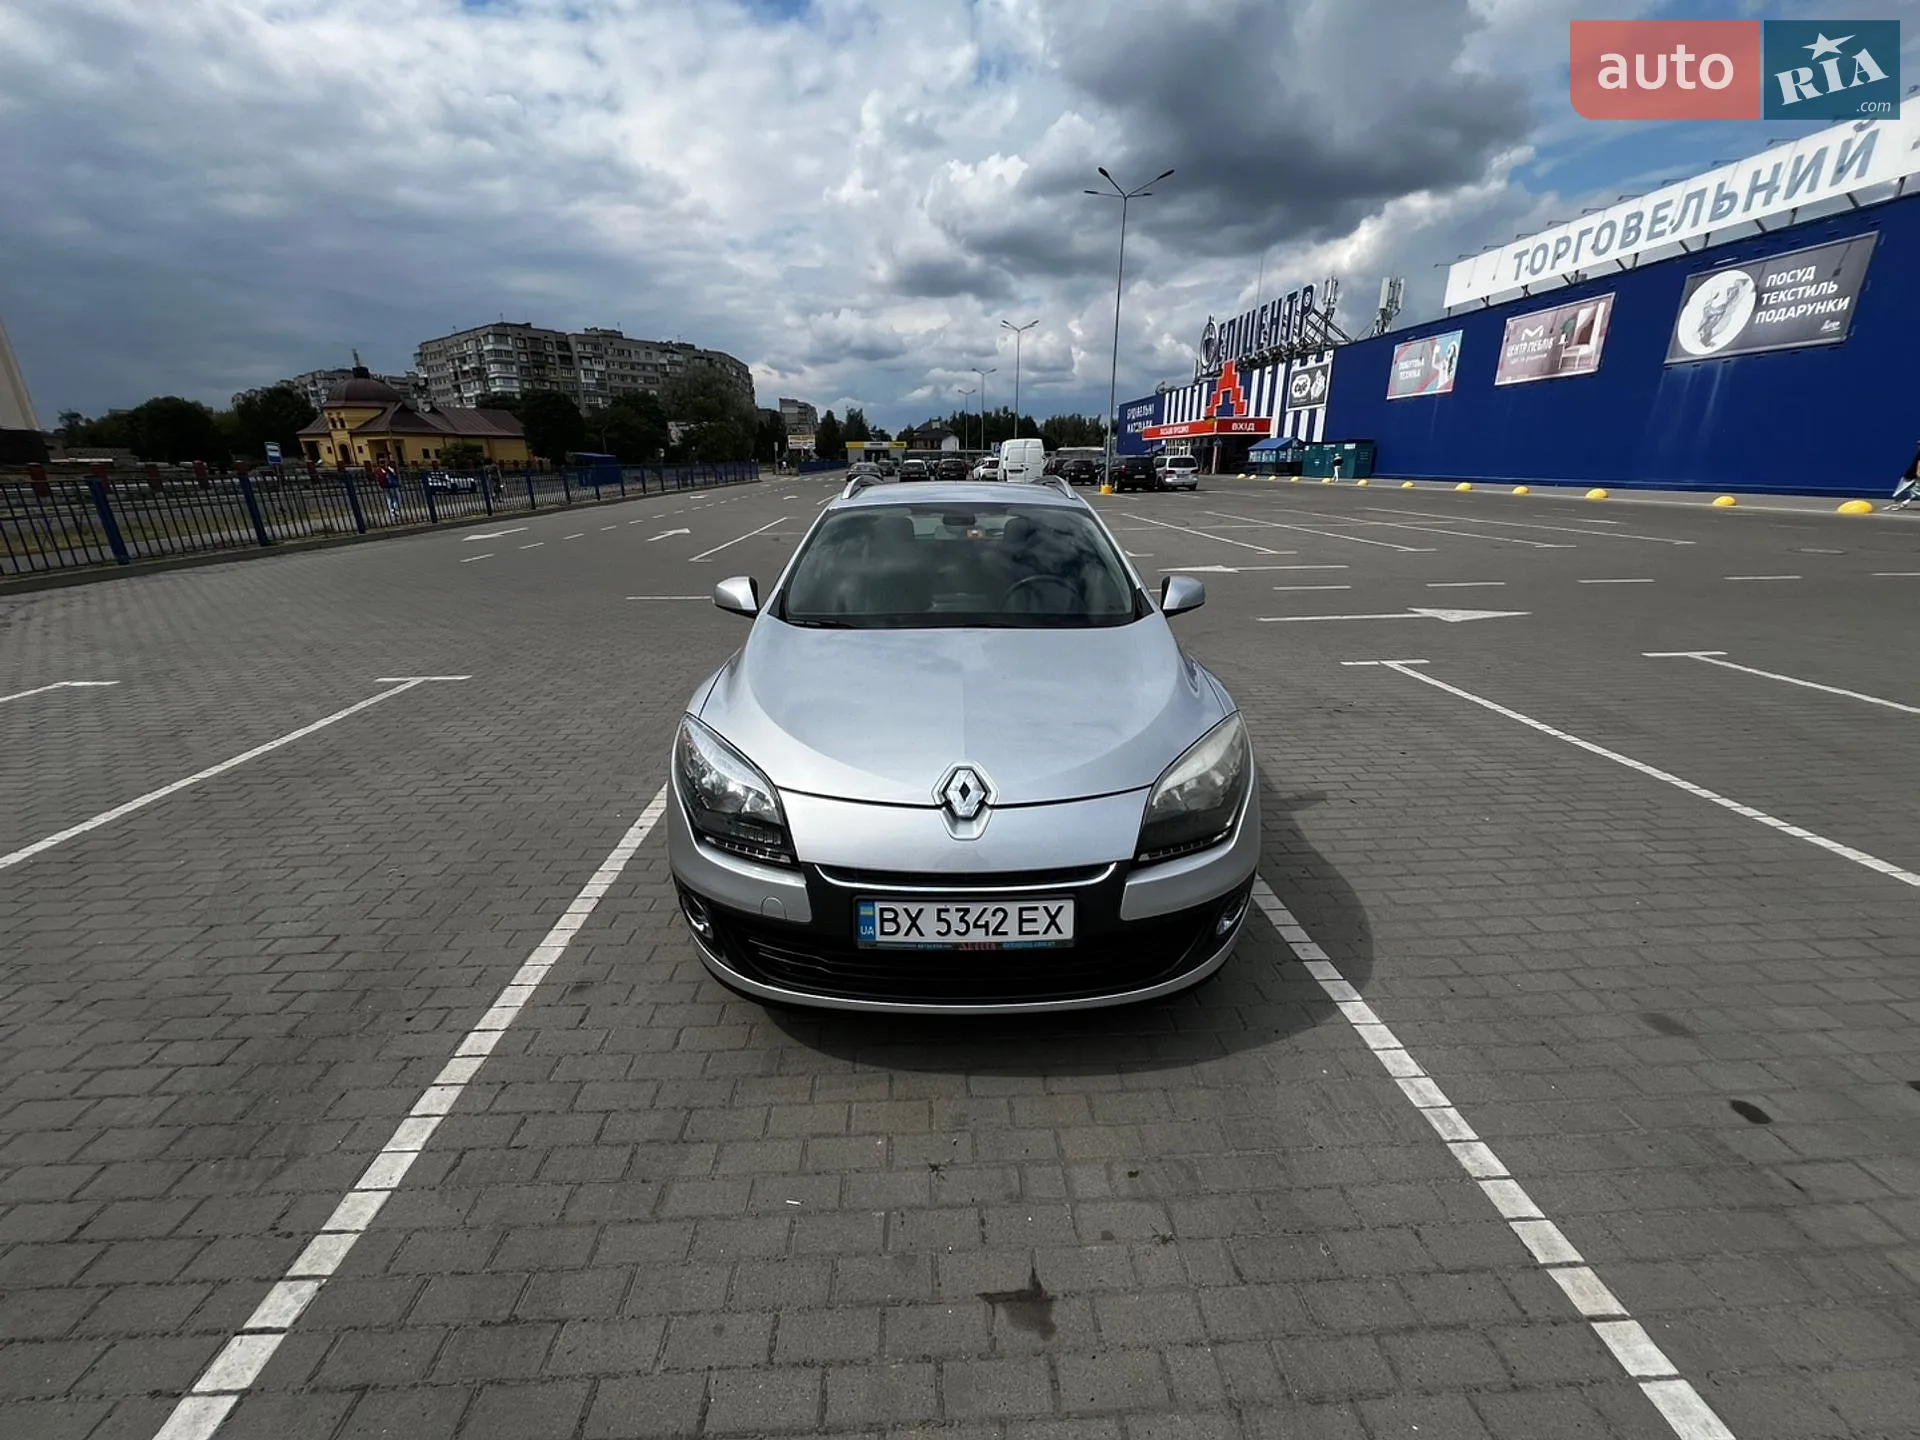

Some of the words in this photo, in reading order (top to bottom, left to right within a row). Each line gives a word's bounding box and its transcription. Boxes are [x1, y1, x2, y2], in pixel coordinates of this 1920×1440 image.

[1512, 119, 1880, 281] ТОРГОВЕЛЬНИЙ
[1765, 265, 1817, 288] ПОСУД
[1761, 280, 1839, 306] ТЕКСТИЛЬ
[1754, 296, 1851, 325] ПОДАРУНКИ
[1231, 422, 1255, 432] ВХІД
[860, 926, 875, 936] UA
[878, 906, 925, 937] BX
[936, 906, 1009, 937] 5342
[1018, 905, 1065, 936] EX
